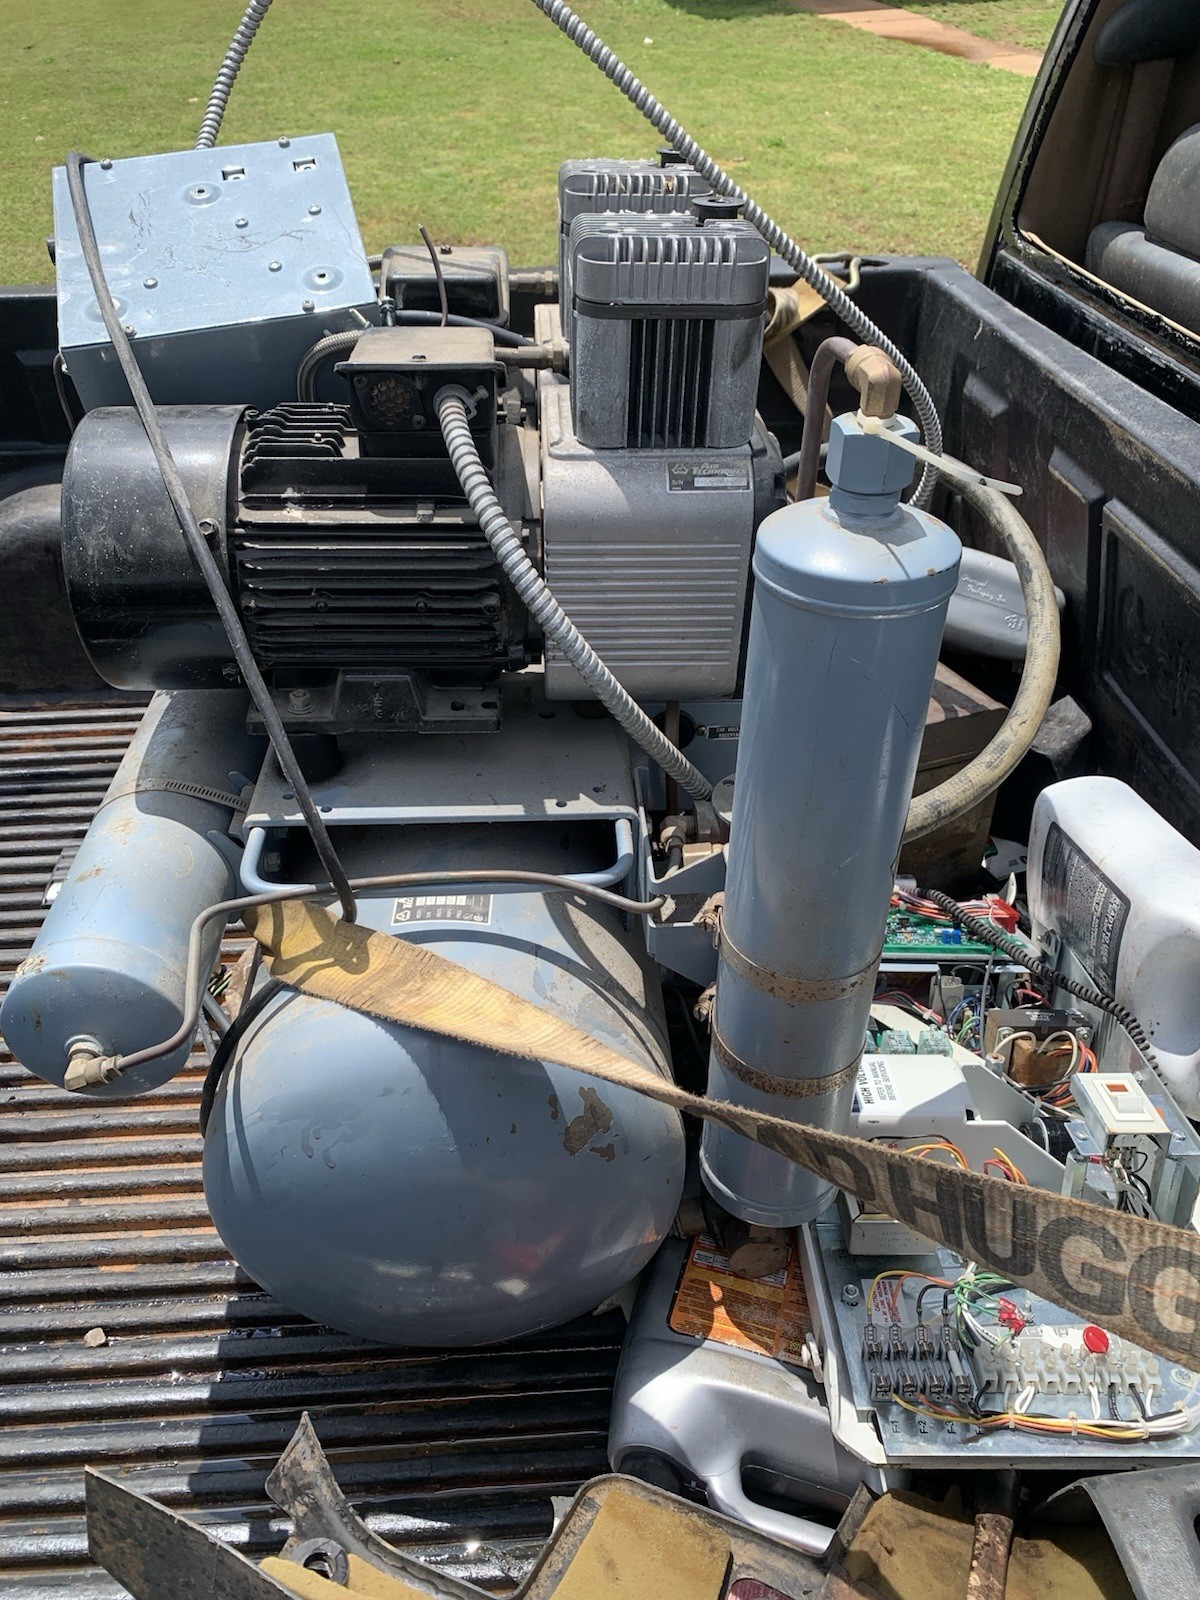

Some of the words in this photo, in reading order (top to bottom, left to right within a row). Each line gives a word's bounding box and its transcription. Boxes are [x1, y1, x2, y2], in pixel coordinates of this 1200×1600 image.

[860, 1087, 874, 1104] HIGH
[877, 1087, 887, 1100] REFER
[885, 1084, 896, 1101] BEFORE
[891, 1421, 900, 1433] F-1
[918, 1421, 928, 1434] F-2
[945, 1421, 956, 1434] F-3
[975, 1424, 984, 1434] F-
